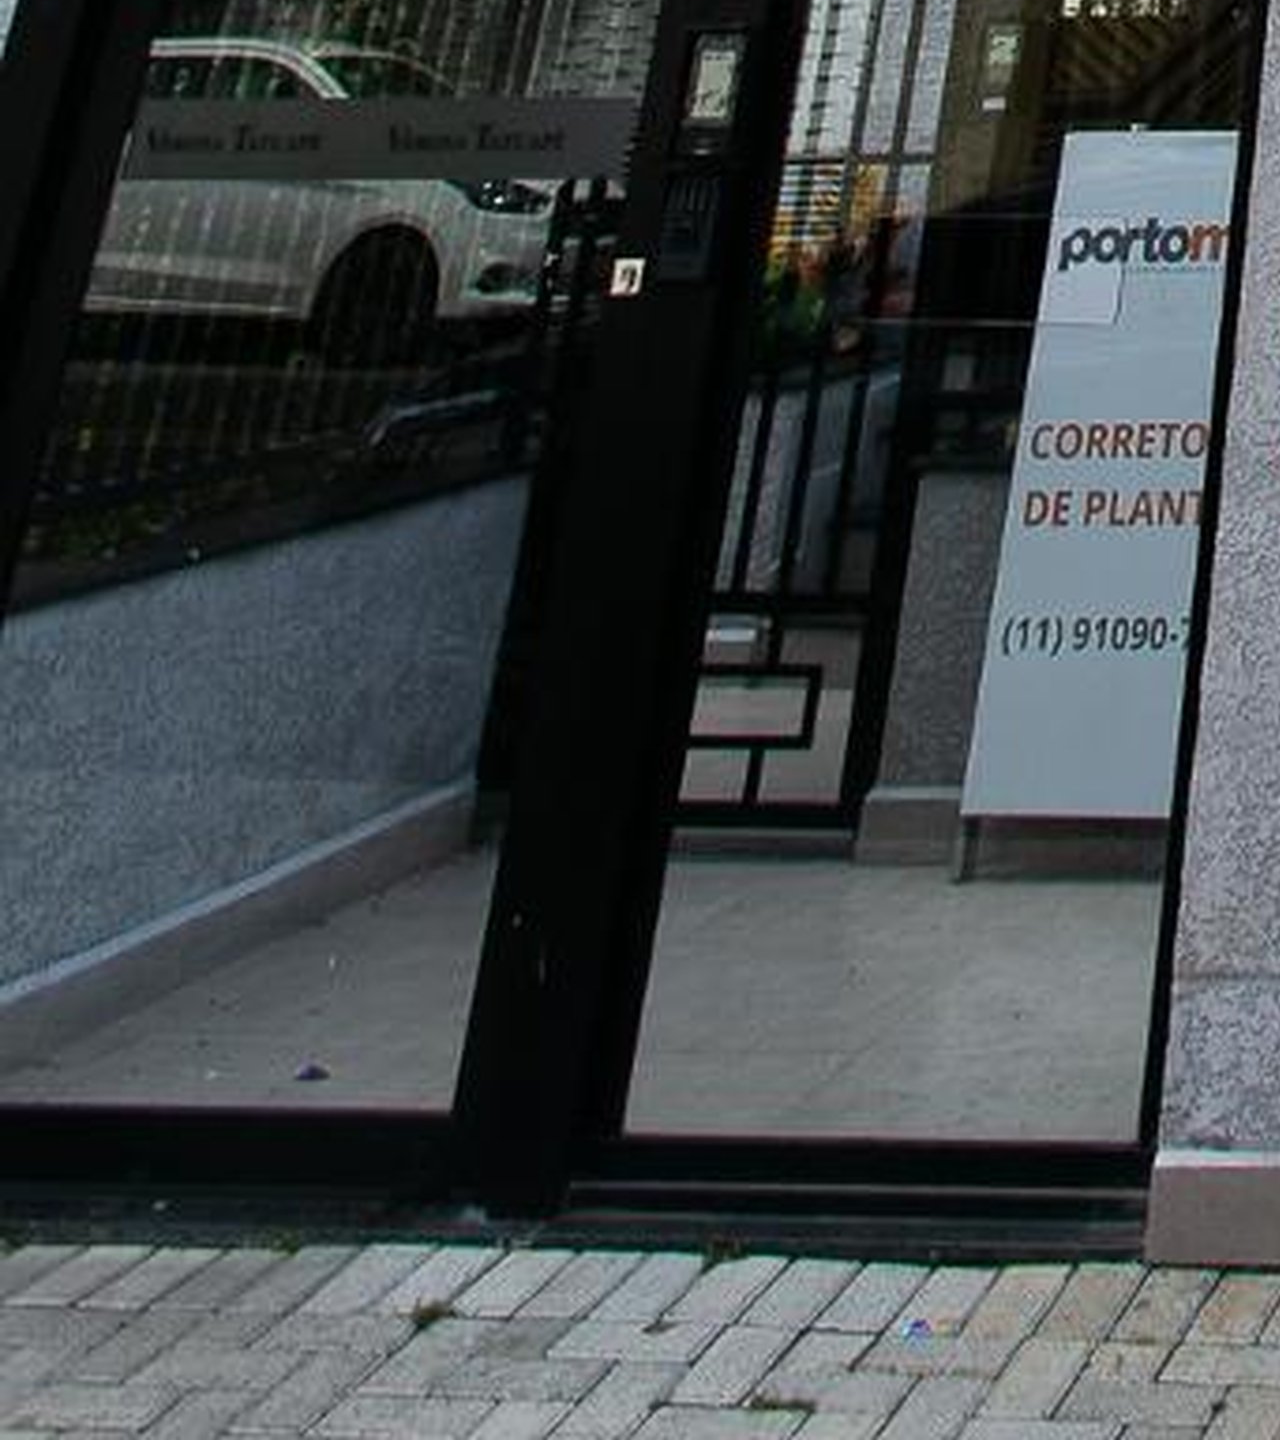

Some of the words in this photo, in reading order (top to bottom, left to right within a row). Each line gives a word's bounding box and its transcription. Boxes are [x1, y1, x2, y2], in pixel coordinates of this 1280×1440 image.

[1031, 423, 1209, 459] CORRETO
[1024, 490, 1072, 527] DE
[1002, 616, 1063, 656] (11)
